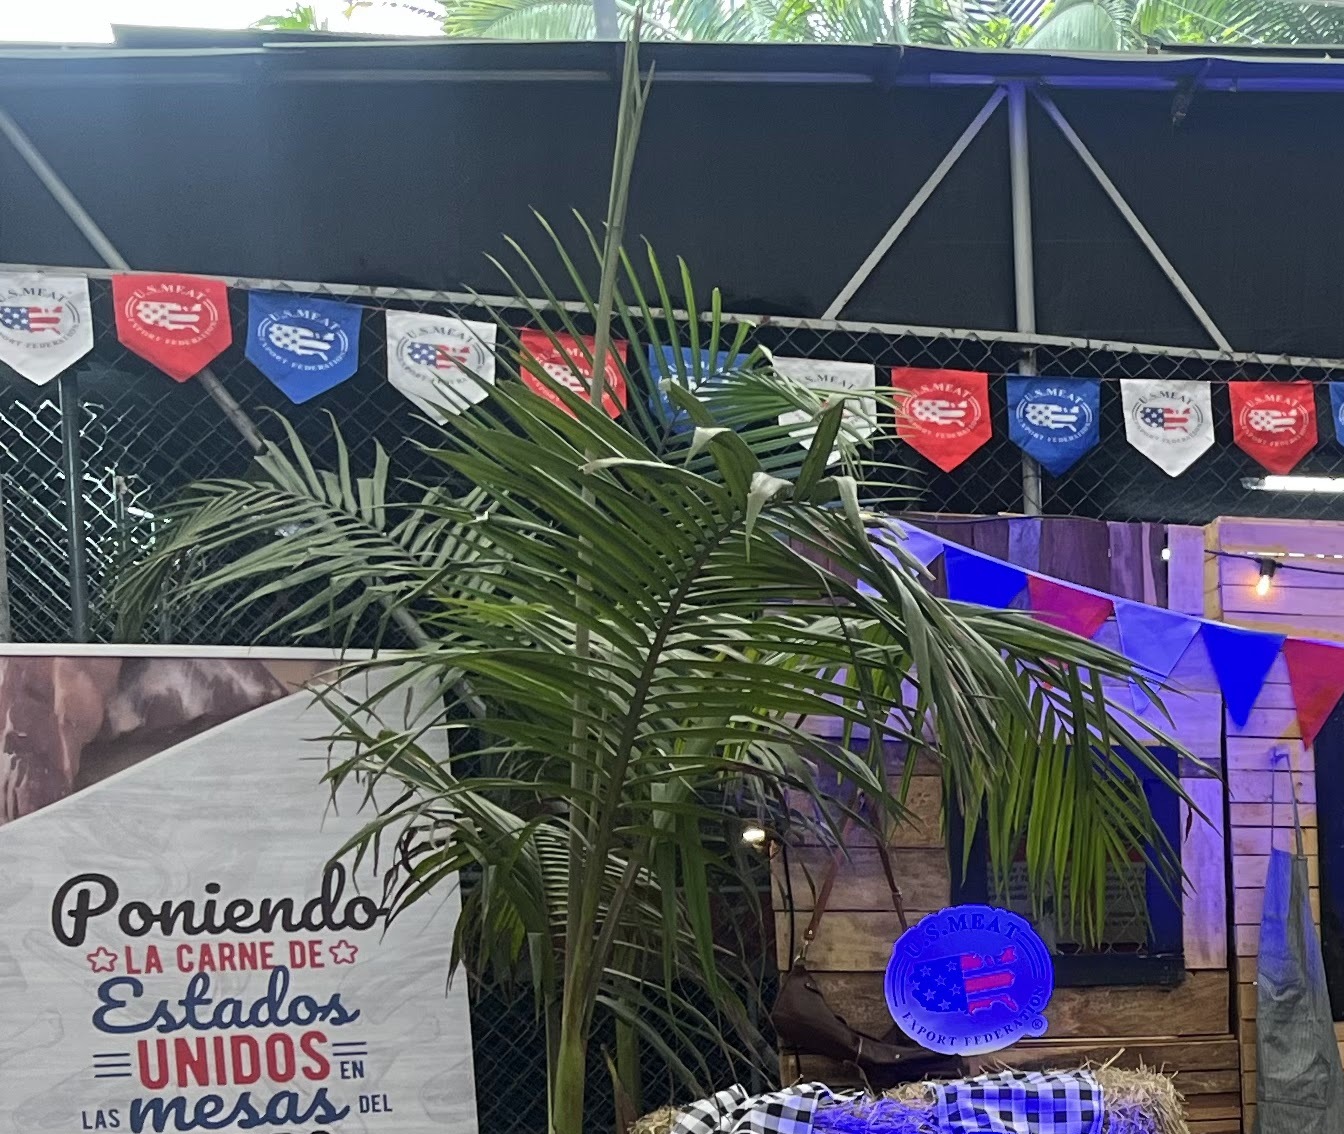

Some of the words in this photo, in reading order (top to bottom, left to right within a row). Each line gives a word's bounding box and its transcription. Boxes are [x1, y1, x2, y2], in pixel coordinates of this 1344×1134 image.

[52, 862, 389, 947] Poniendo
[124, 944, 164, 975] LA
[176, 941, 276, 972] CARNE
[288, 940, 325, 968] DE
[92, 965, 361, 1034] Estados
[902, 1012, 957, 1047] EXPORT
[965, 985, 1045, 1047] FEDERATION
[137, 1030, 331, 1090] UNIDOS
[340, 1060, 365, 1080] EN
[82, 1109, 121, 1130] LAS
[129, 1087, 350, 1134] mesas
[359, 1094, 393, 1114] DEL
